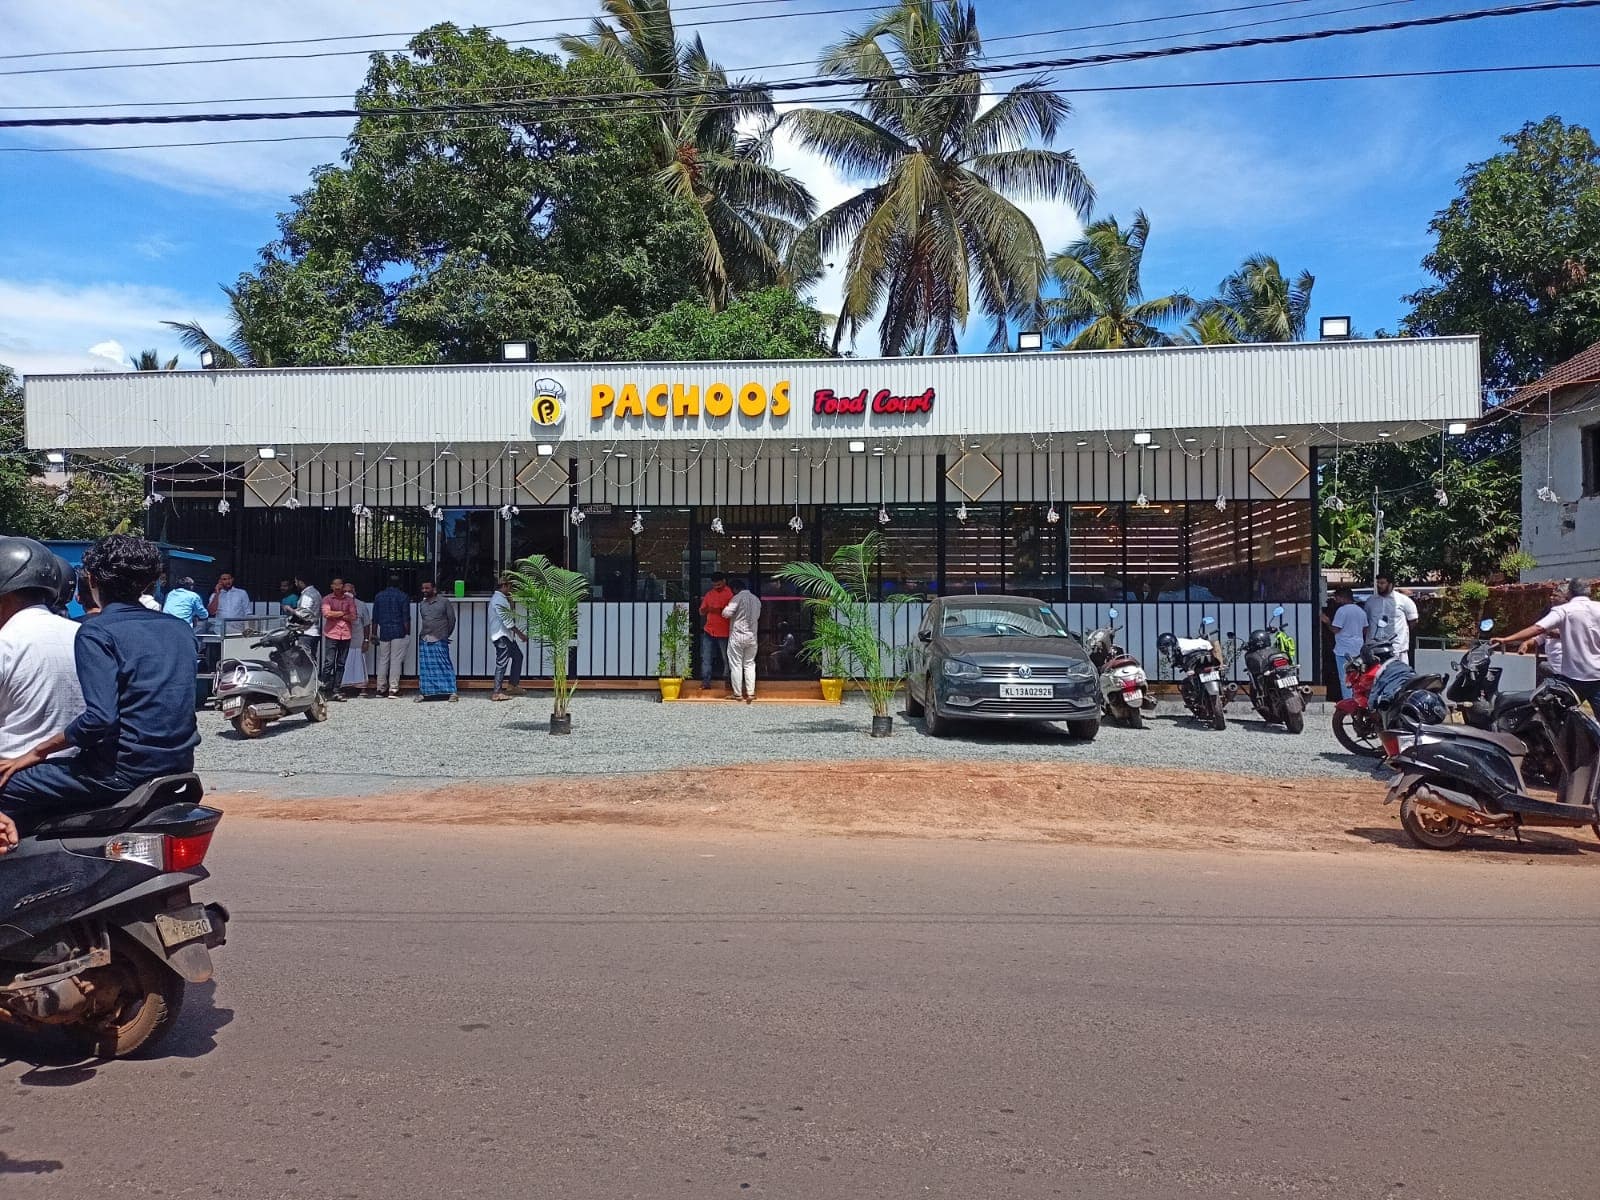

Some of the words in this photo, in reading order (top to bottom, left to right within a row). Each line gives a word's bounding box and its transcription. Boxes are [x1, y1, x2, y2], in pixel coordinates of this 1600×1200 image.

[590, 380, 791, 418] PACHOOS
[814, 388, 869, 414] Food
[872, 387, 936, 414] Court
